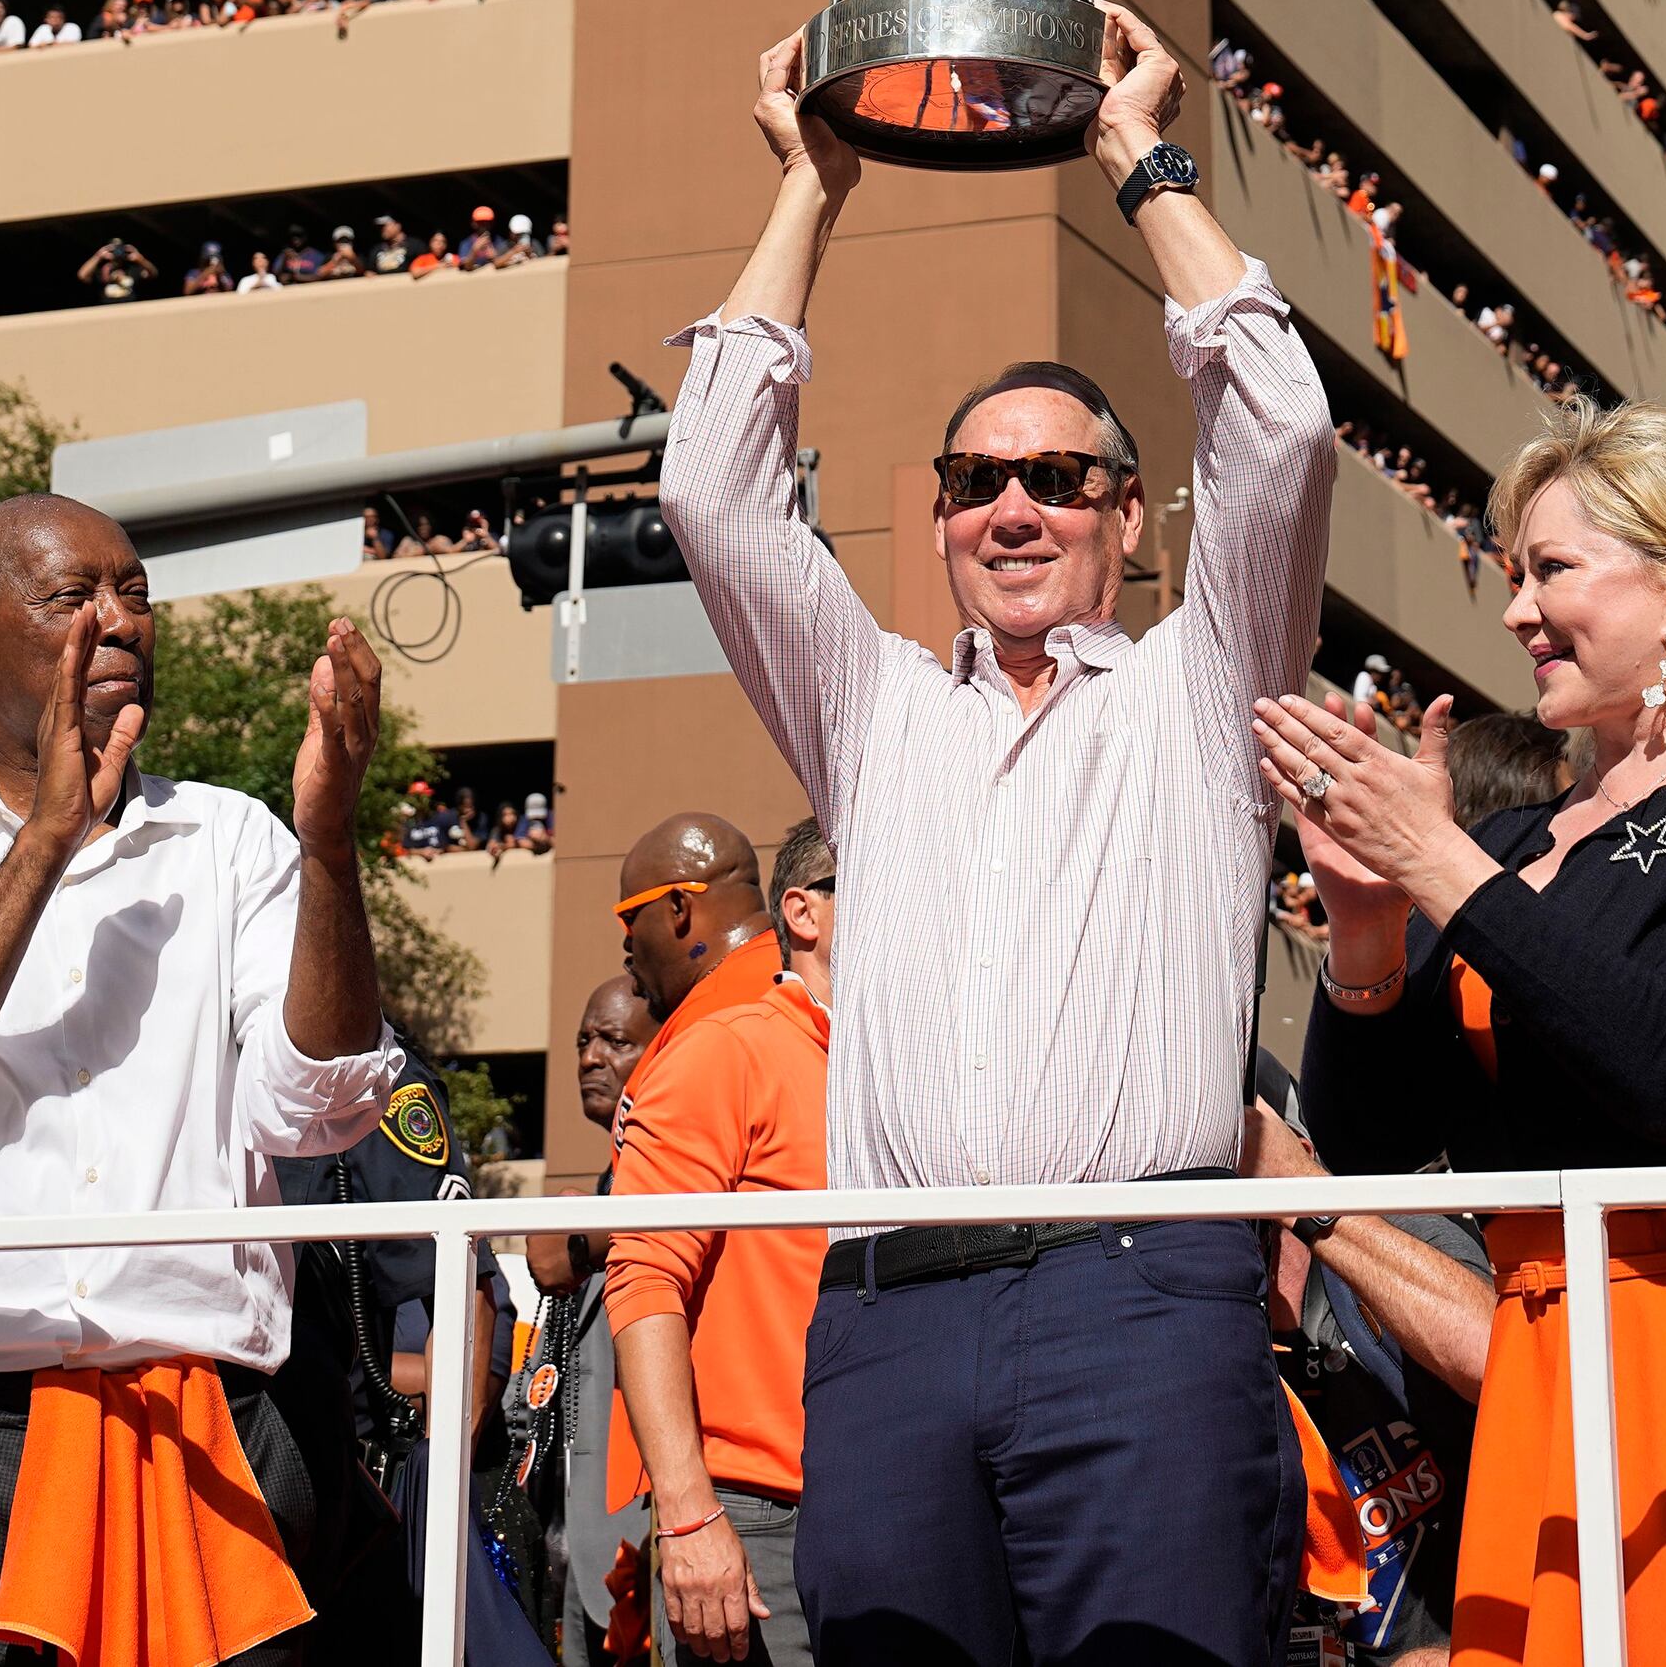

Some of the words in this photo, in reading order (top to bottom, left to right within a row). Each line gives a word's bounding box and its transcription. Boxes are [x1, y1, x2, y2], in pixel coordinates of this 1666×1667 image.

[831, 6, 908, 50] SERIES
[915, 3, 1085, 50] CHAMPIONS
[385, 1088, 426, 1119] HOUSTON
[1354, 1468, 1389, 1495] IES
[1359, 1459, 1440, 1538] ONS
[1286, 1649, 1319, 1662] POSTSEASO
